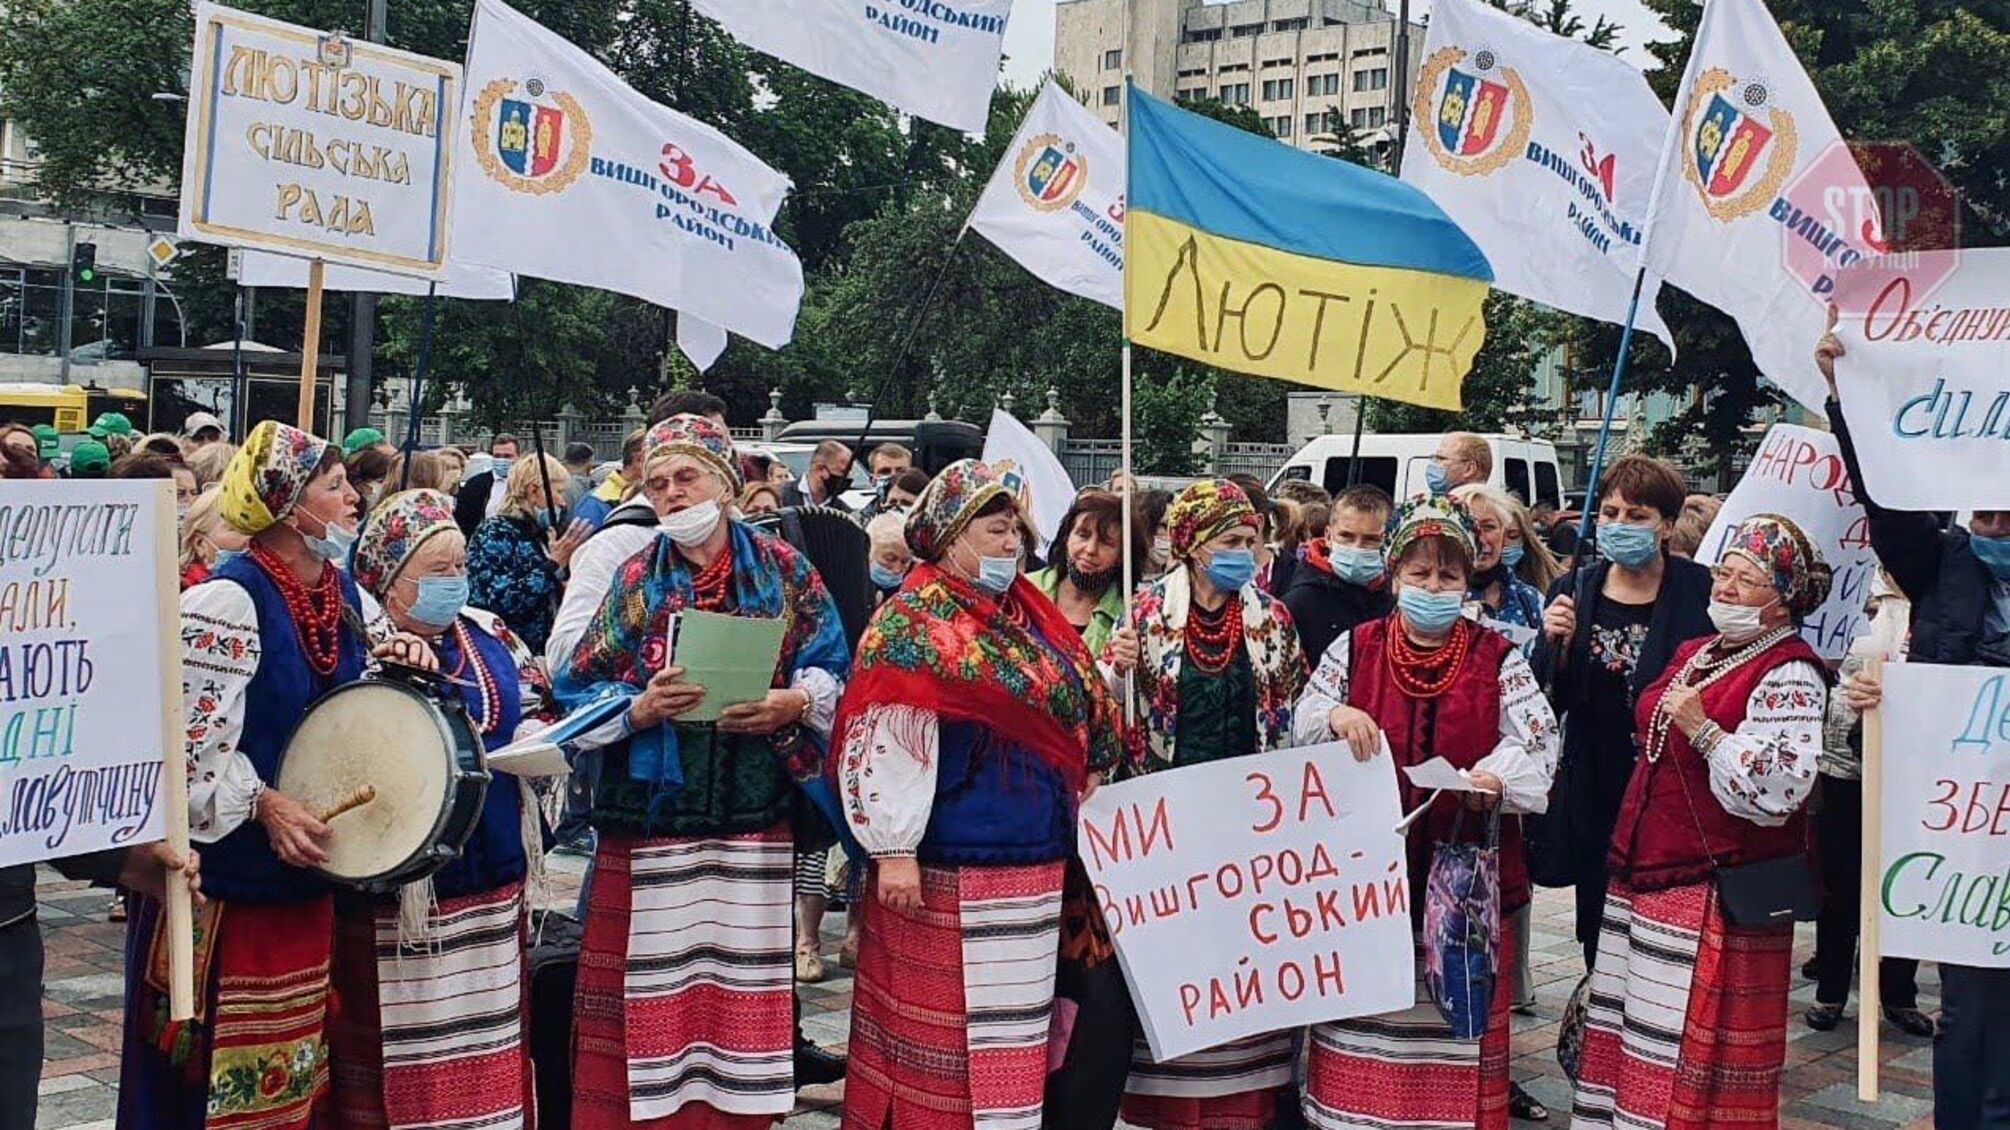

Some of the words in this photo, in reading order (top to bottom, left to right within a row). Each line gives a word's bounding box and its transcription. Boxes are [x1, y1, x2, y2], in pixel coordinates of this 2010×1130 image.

[866, 6, 939, 44] РАЙОН
[221, 45, 437, 137] ЛЮТІЗЬКА
[275, 183, 376, 237] РАДА
[659, 143, 737, 206] ЗА
[656, 203, 735, 251] РАЙОН
[1768, 197, 1861, 267] ВИШГО
[0, 764, 165, 850] лавутчину
[1083, 796, 1174, 871] МИ
[1246, 761, 1336, 833] ЗА
[1250, 861, 1407, 944] СЬКИЙ
[1881, 851, 2010, 955] Слав
[1179, 951, 1345, 1026] РАЙОН
